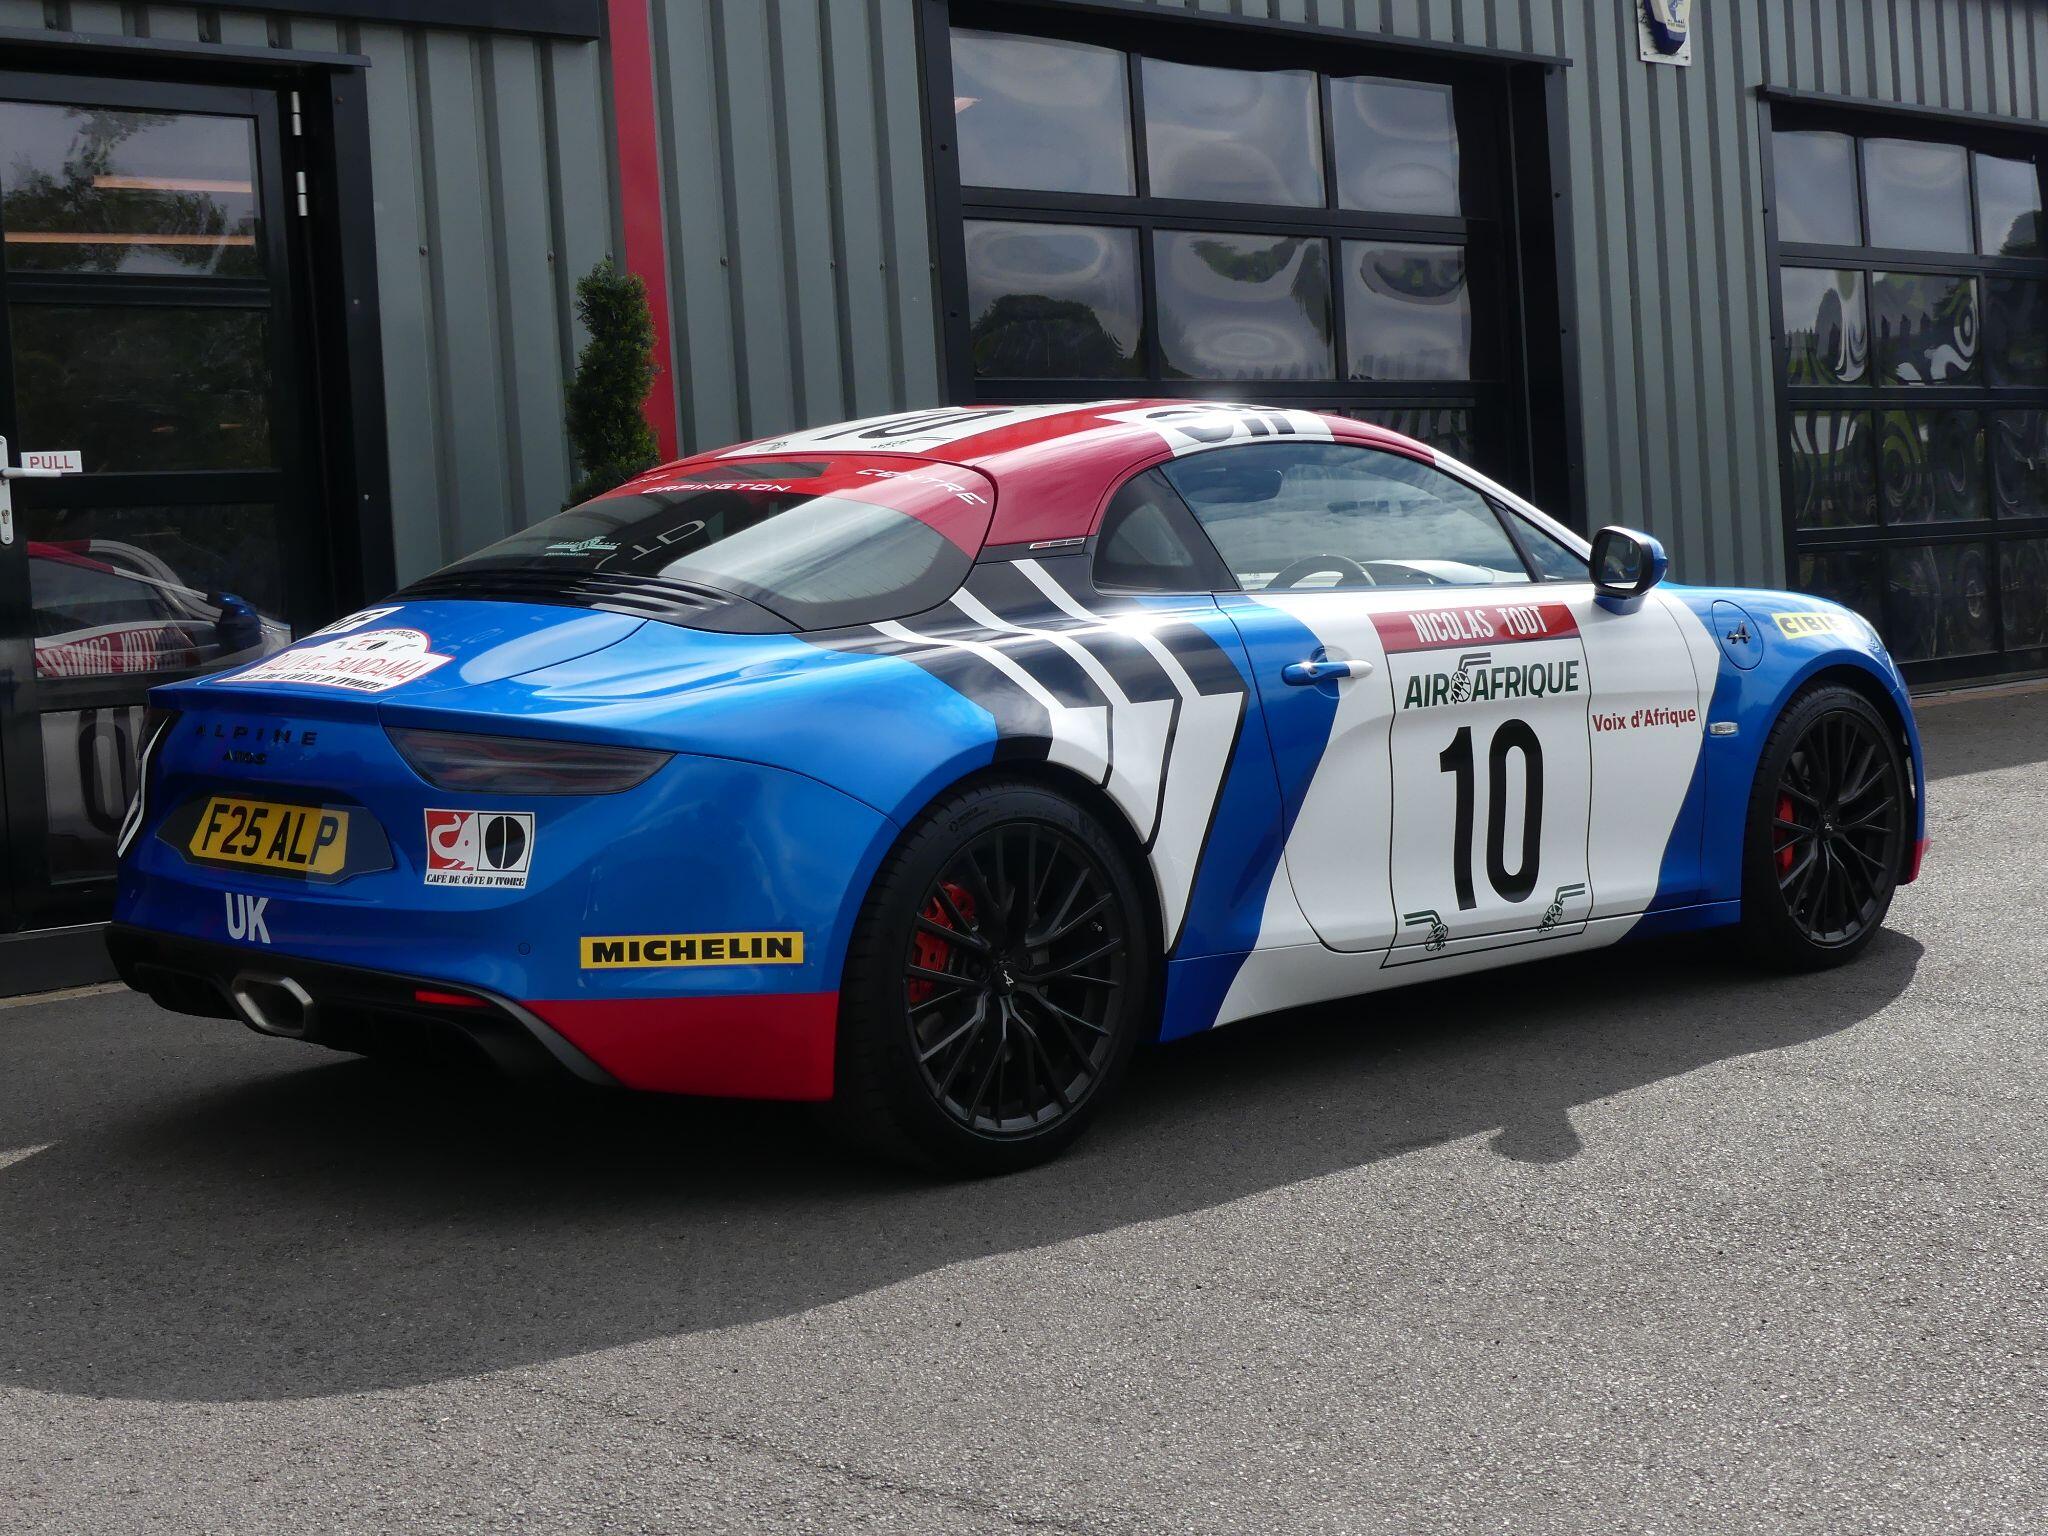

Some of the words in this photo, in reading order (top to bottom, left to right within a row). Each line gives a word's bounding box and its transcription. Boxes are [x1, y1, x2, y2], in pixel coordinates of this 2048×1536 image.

[29, 455, 74, 469] PULL
[641, 483, 792, 494] ORPINGTON
[856, 468, 987, 506] CENTRE
[1408, 609, 1495, 643] NICOLAS
[1496, 605, 1547, 636] TODT
[1403, 673, 1450, 709] AIR
[1471, 660, 1579, 702] AFRIQUE
[195, 723, 318, 746] ALPINE
[1592, 712, 1627, 732] Voix
[1630, 707, 1696, 728] d'Afrique
[1439, 718, 1543, 911] 10
[202, 803, 268, 856] F25
[266, 811, 339, 865] ALP
[426, 871, 447, 883] CAFÉ
[448, 875, 460, 884] DE
[462, 874, 486, 885] CÔTE
[225, 892, 271, 944] UK
[592, 937, 792, 963] MICHELIN
